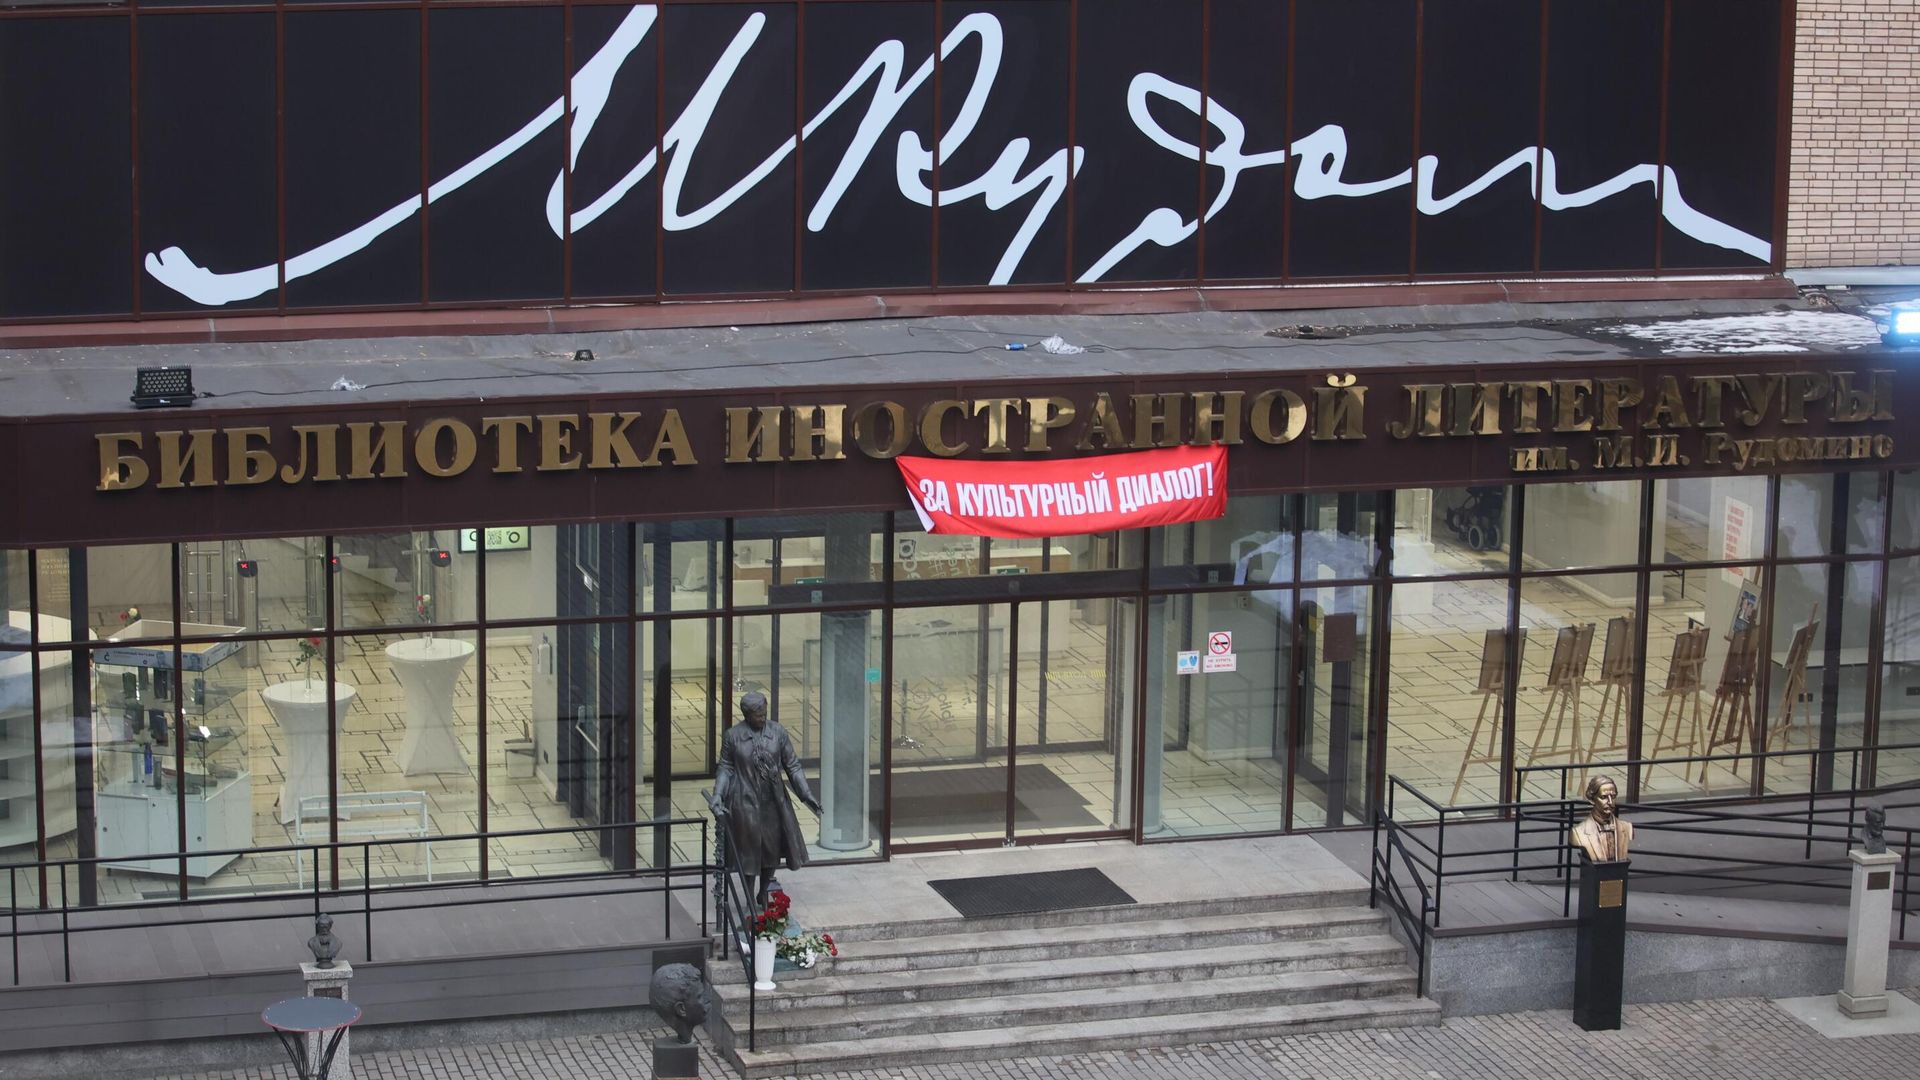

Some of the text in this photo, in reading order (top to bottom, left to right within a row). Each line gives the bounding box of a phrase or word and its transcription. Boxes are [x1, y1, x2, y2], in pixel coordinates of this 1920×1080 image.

[95, 369, 1897, 491] БИБЛИОТЕКА ИНОСТРАННОЙ ЛИТЕРАТУРЫ
[1510, 447, 1581, 472] им.
[1704, 432, 1895, 471] Рудомино
[919, 461, 1214, 518] ЗА КУЛЬТУРНЫЙ ДИАЛОГ!
